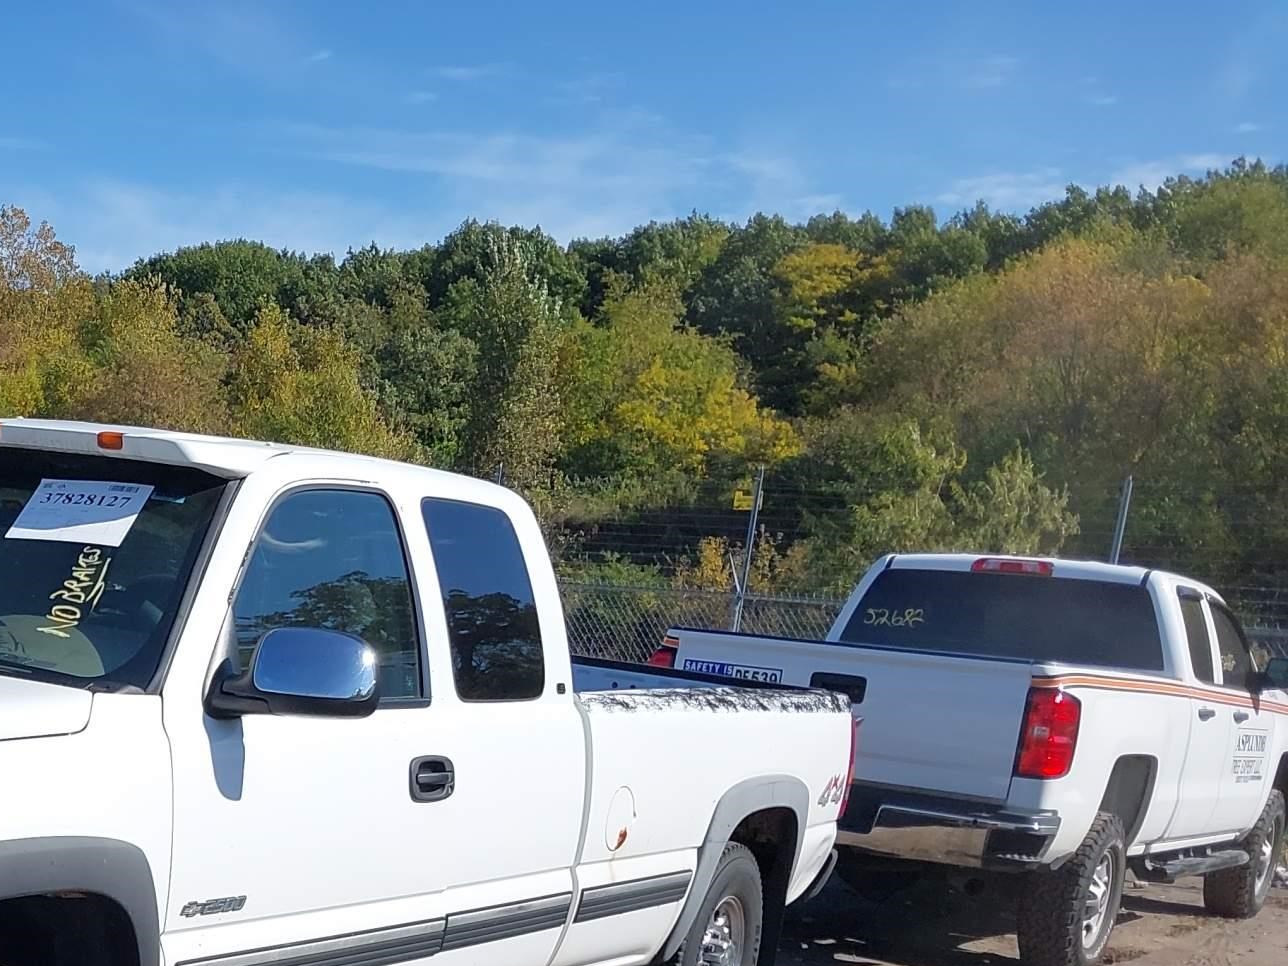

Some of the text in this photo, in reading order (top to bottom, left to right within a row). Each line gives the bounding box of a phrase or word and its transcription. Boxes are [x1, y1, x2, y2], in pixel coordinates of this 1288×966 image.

[40, 492, 132, 508] 37828127
[36, 605, 81, 638] NO
[685, 661, 733, 675] SAFETY IS
